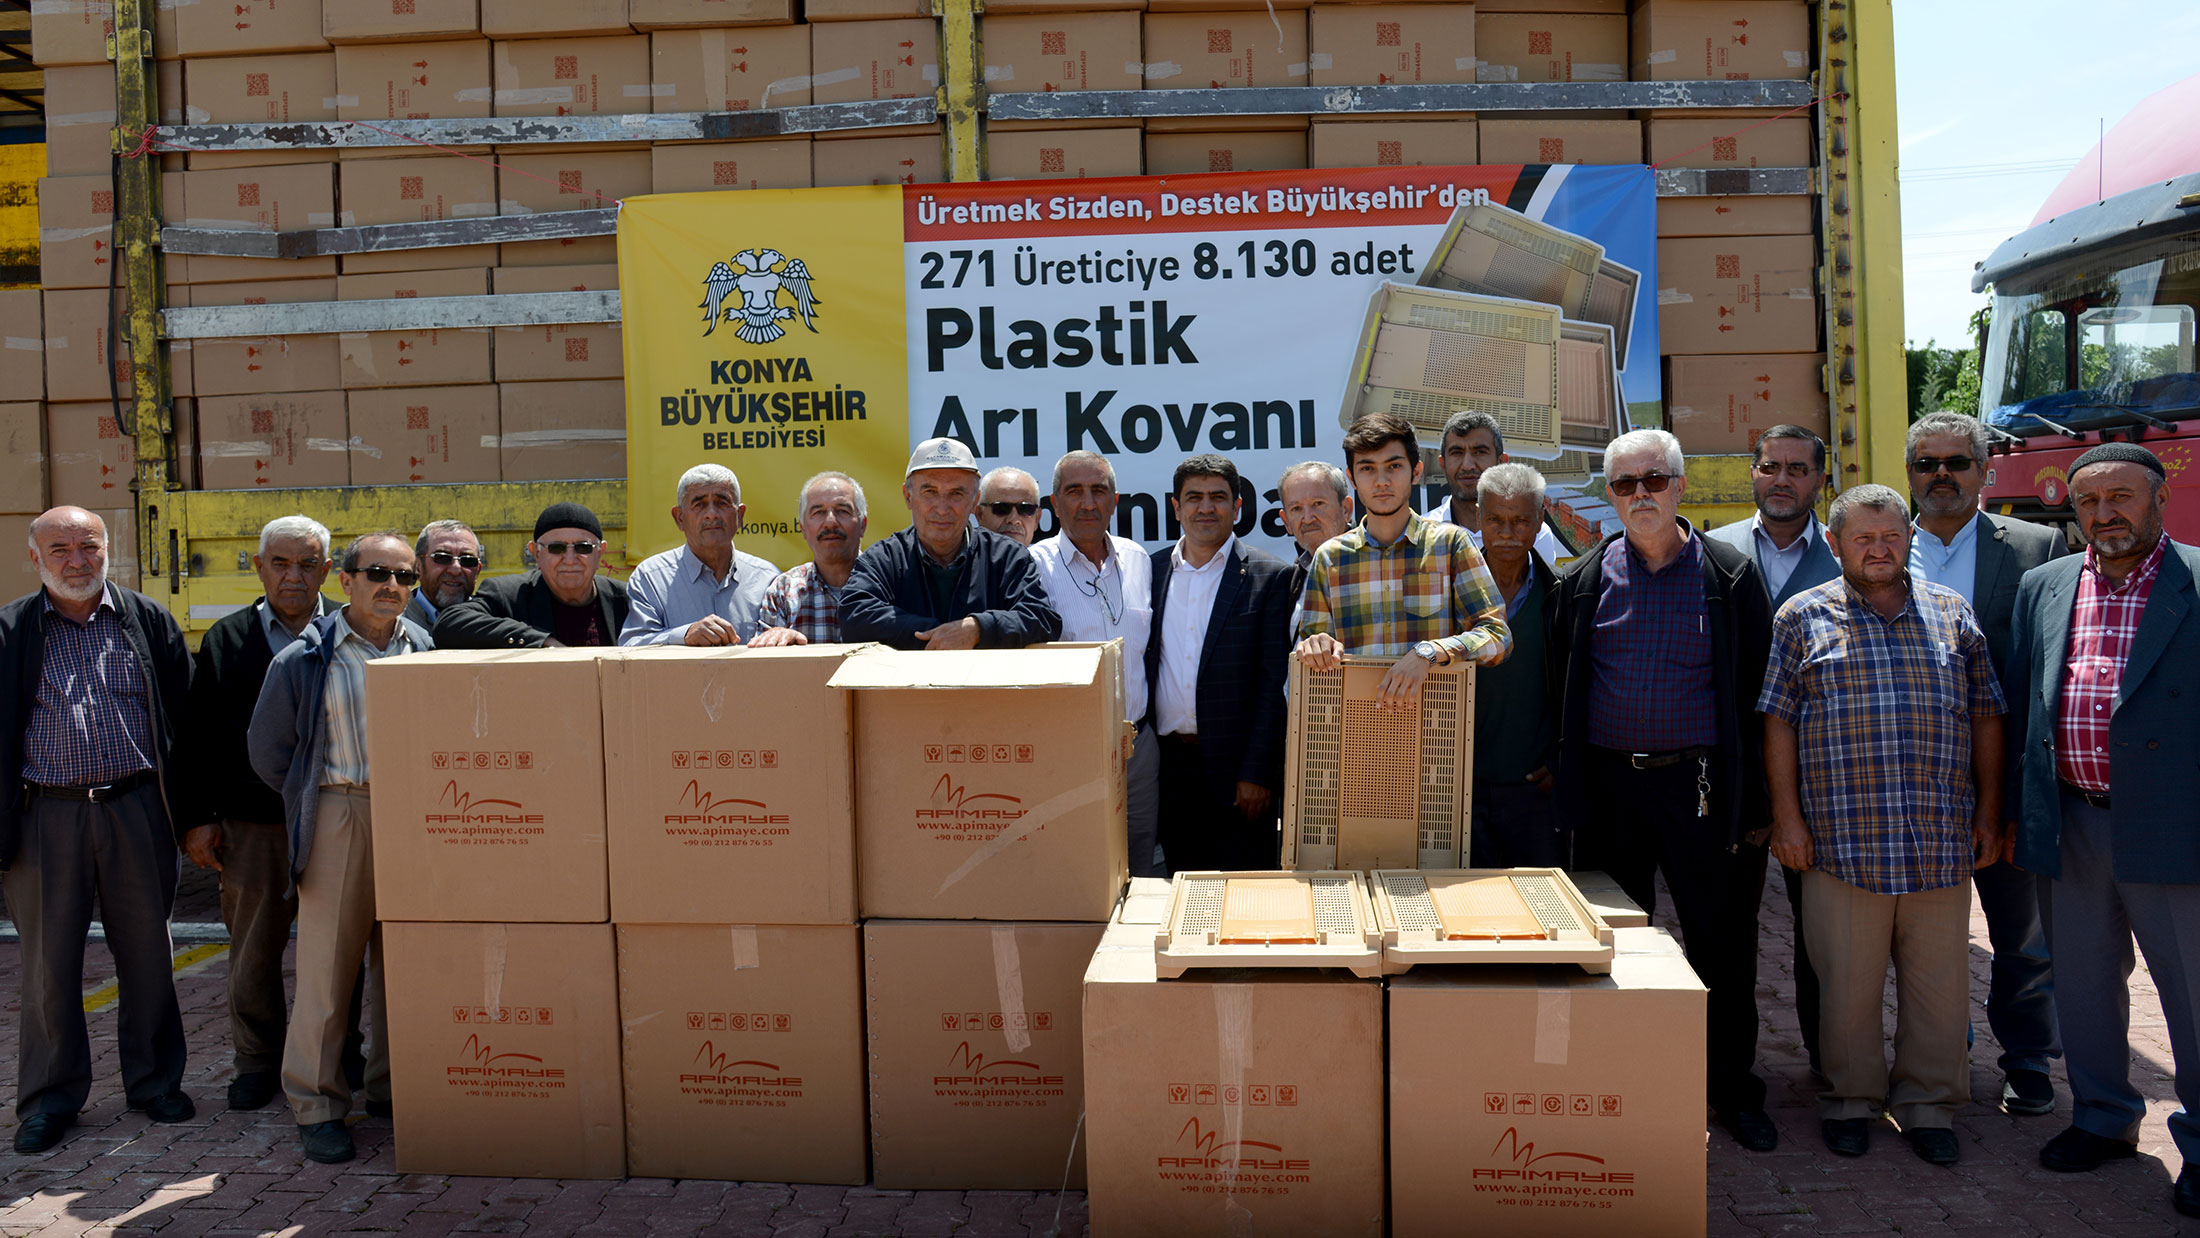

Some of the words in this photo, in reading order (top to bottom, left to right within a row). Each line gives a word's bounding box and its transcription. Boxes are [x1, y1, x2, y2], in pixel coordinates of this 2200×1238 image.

[918, 196, 1042, 225] Üretmek
[1048, 195, 1152, 222] Sizden,
[1160, 189, 1259, 217] Destek
[920, 250, 995, 290] 271
[1014, 246, 1180, 291] Üreticiye
[1193, 239, 1317, 280] 8.130
[1330, 241, 1415, 275] adet
[926, 300, 1199, 372] Plastik
[711, 357, 813, 385] KONYA
[660, 384, 867, 427] BÜYÜKŞEHİR
[930, 396, 1039, 458] Arı
[1066, 390, 1317, 455] Kovanı
[703, 425, 825, 450] BELEDİYESİ
[425, 814, 544, 824] APIMAYE
[664, 815, 789, 825] APIMAYE
[915, 809, 1029, 819] APIMAY
[426, 825, 545, 836] www.apimaye.com
[665, 825, 790, 838] www.apimaye.com
[701, 839, 713, 847] (0)
[715, 839, 730, 847] 212
[732, 839, 748, 847] 876
[750, 839, 761, 847] 76
[762, 839, 773, 847] 55
[953, 834, 965, 842] (0)
[447, 1066, 565, 1078] APIMAYE
[447, 1078, 566, 1089] www.apimaye.com
[680, 1074, 803, 1087] APIMAYE
[933, 1076, 1064, 1086] APIMAYE
[681, 1086, 803, 1098] www.apimaye.com
[934, 1087, 1064, 1099] www.apimaye.com
[1158, 1157, 1310, 1170] APIMAYE
[1159, 1171, 1310, 1185] www.apimaye.com
[1472, 1168, 1634, 1183] APIMAYE
[1180, 1185, 1199, 1193] +90
[1202, 1186, 1215, 1194] (0)
[1261, 1187, 1274, 1195] 76
[1276, 1187, 1289, 1195] 55
[1473, 1184, 1634, 1198] www.apimaye.com
[1495, 1198, 1516, 1206] +90
[1519, 1199, 1533, 1207] (0)
[1537, 1199, 1557, 1207] 212
[1559, 1200, 1580, 1208] 876
[1598, 1201, 1613, 1209] 55
